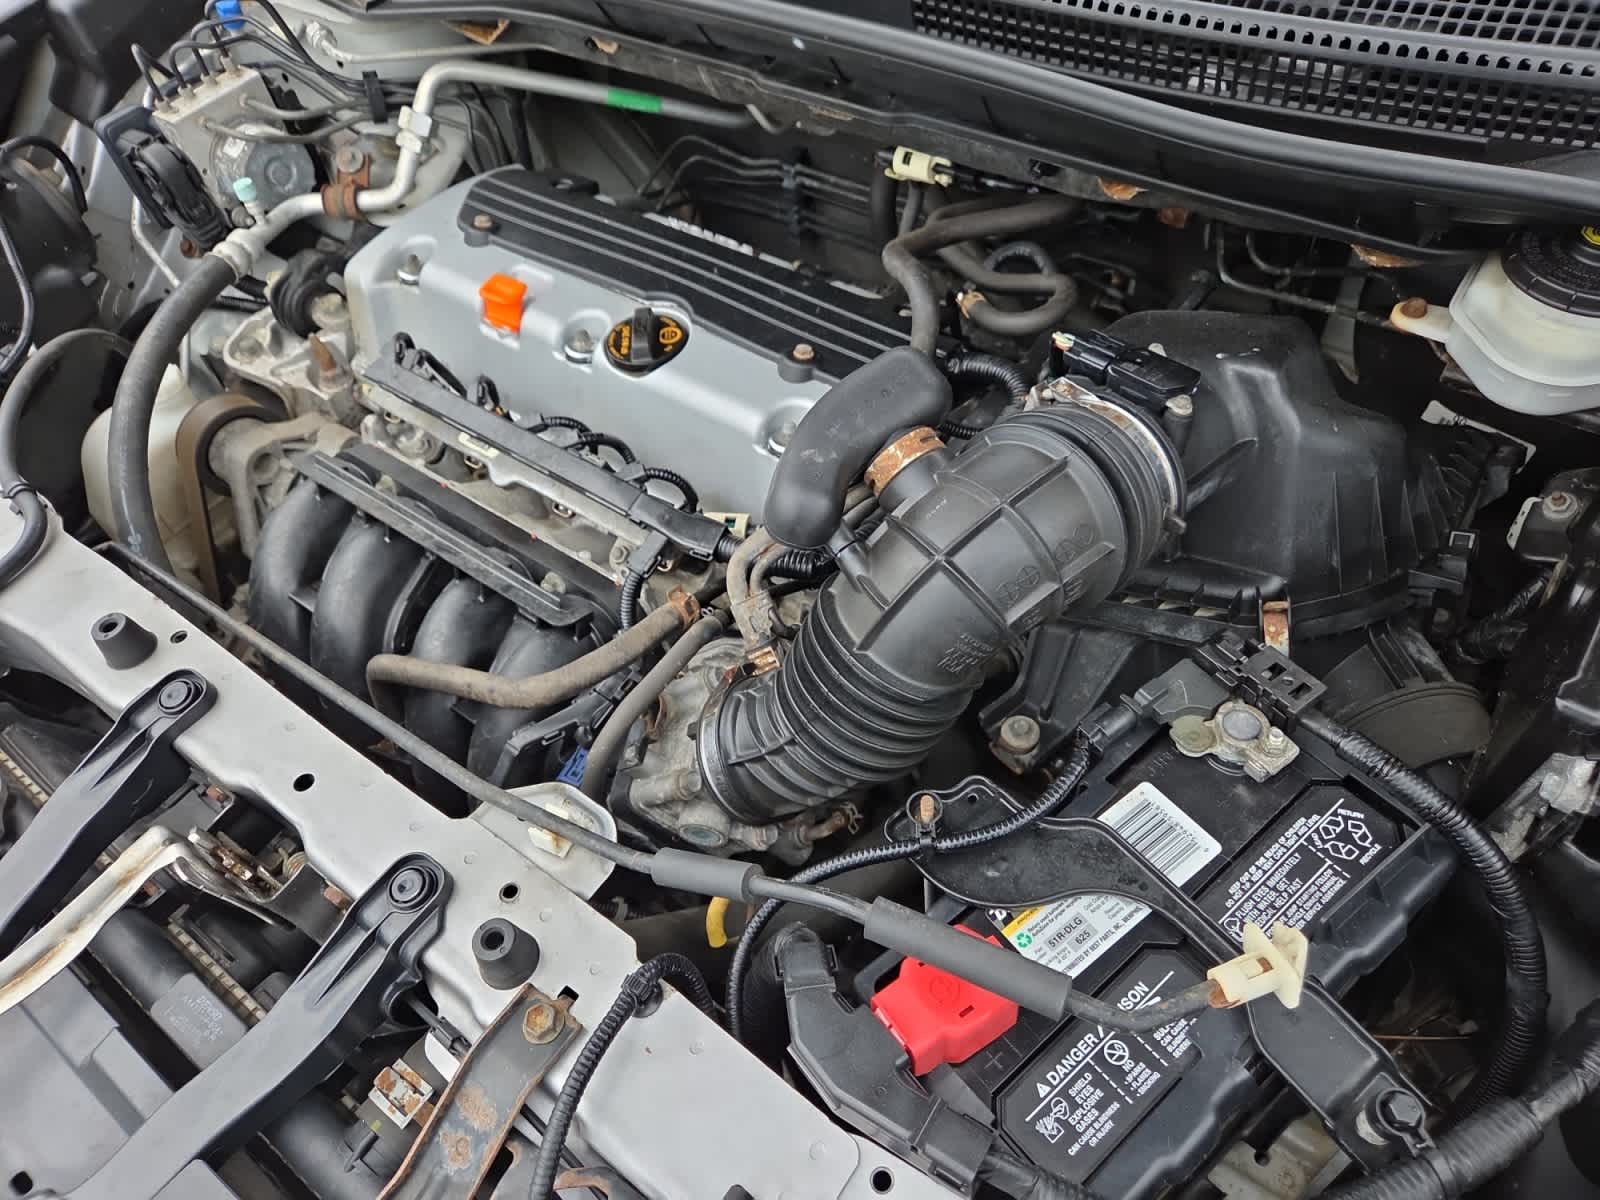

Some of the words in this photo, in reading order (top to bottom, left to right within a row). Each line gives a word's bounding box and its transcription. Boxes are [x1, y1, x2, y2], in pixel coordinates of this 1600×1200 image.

[1235, 898, 1256, 919] FLUSH
[1251, 884, 1270, 902] EYES
[1264, 852, 1302, 888] IMMEDIATELY
[1275, 877, 1291, 892] GET
[1272, 891, 1290, 908] HELP
[1047, 915, 1083, 948] 51R-DLG
[1073, 929, 1091, 945] 625
[1044, 1031, 1100, 1086] DANGER
[1121, 1058, 1136, 1073] NO
[1067, 1070, 1093, 1097] SHIELD
[1073, 1083, 1095, 1104] EYES
[1067, 1087, 1105, 1126] EXPLOSIVE
[1073, 1106, 1100, 1133] GASES
